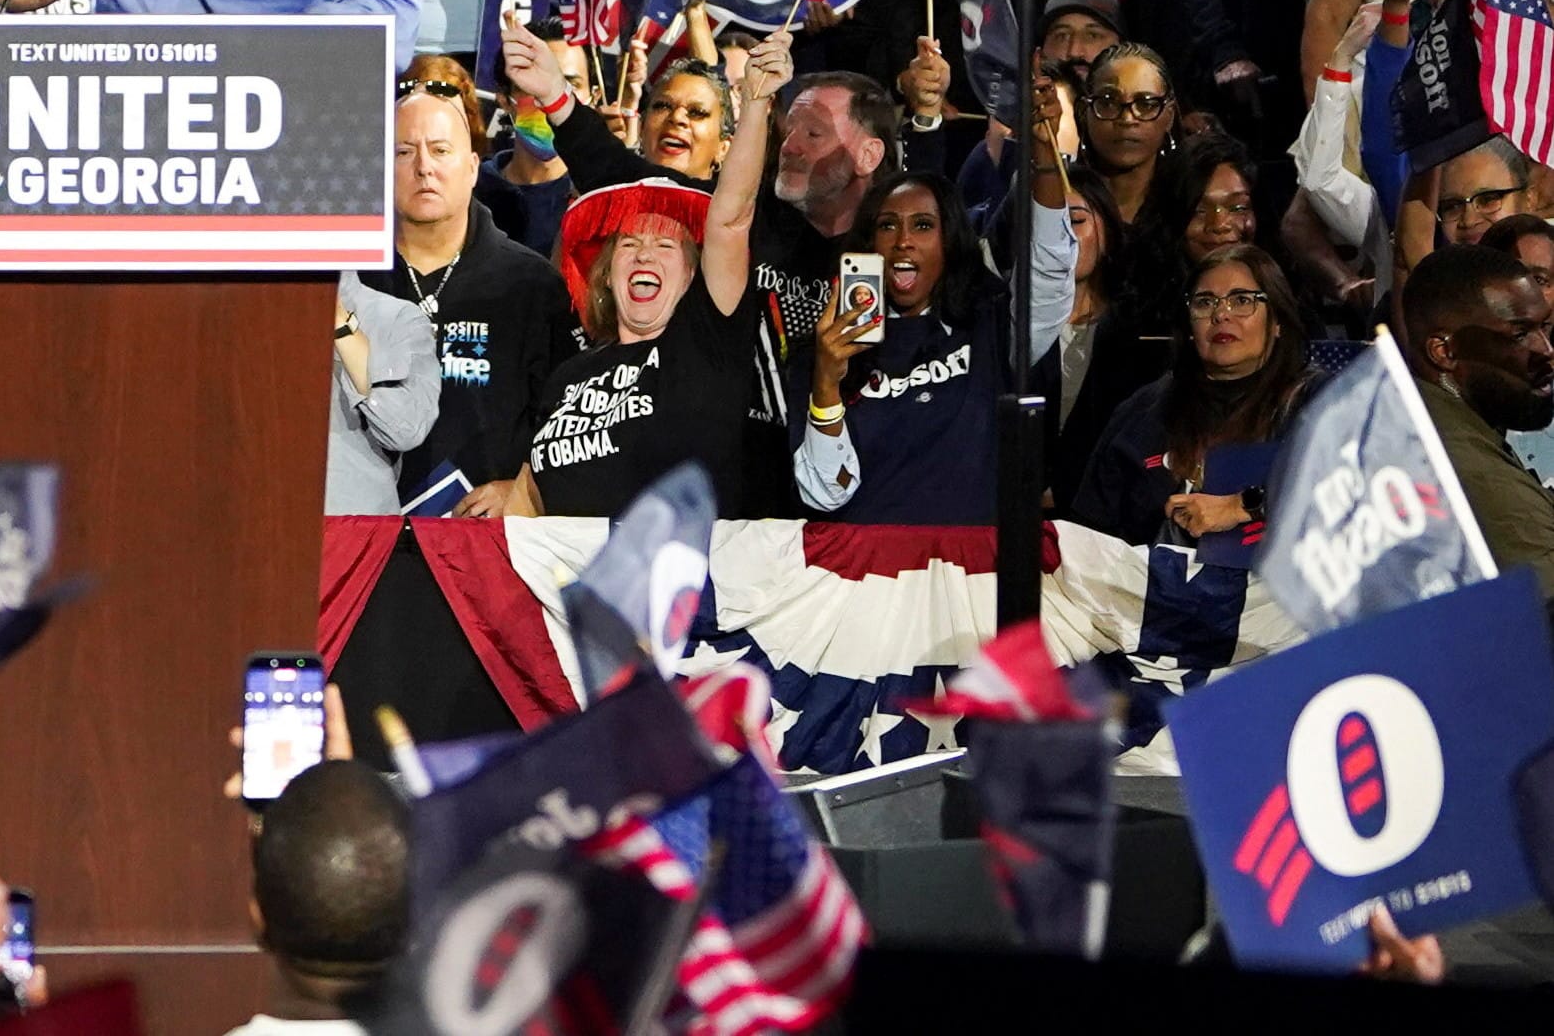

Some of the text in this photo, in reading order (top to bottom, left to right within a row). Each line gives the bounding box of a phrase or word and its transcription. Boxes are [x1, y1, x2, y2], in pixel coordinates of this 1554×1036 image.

[8, 43, 217, 62] TEXT UNITED TO 51015
[7, 157, 261, 206] GEORGIA
[547, 429, 620, 468] OBAMA.
